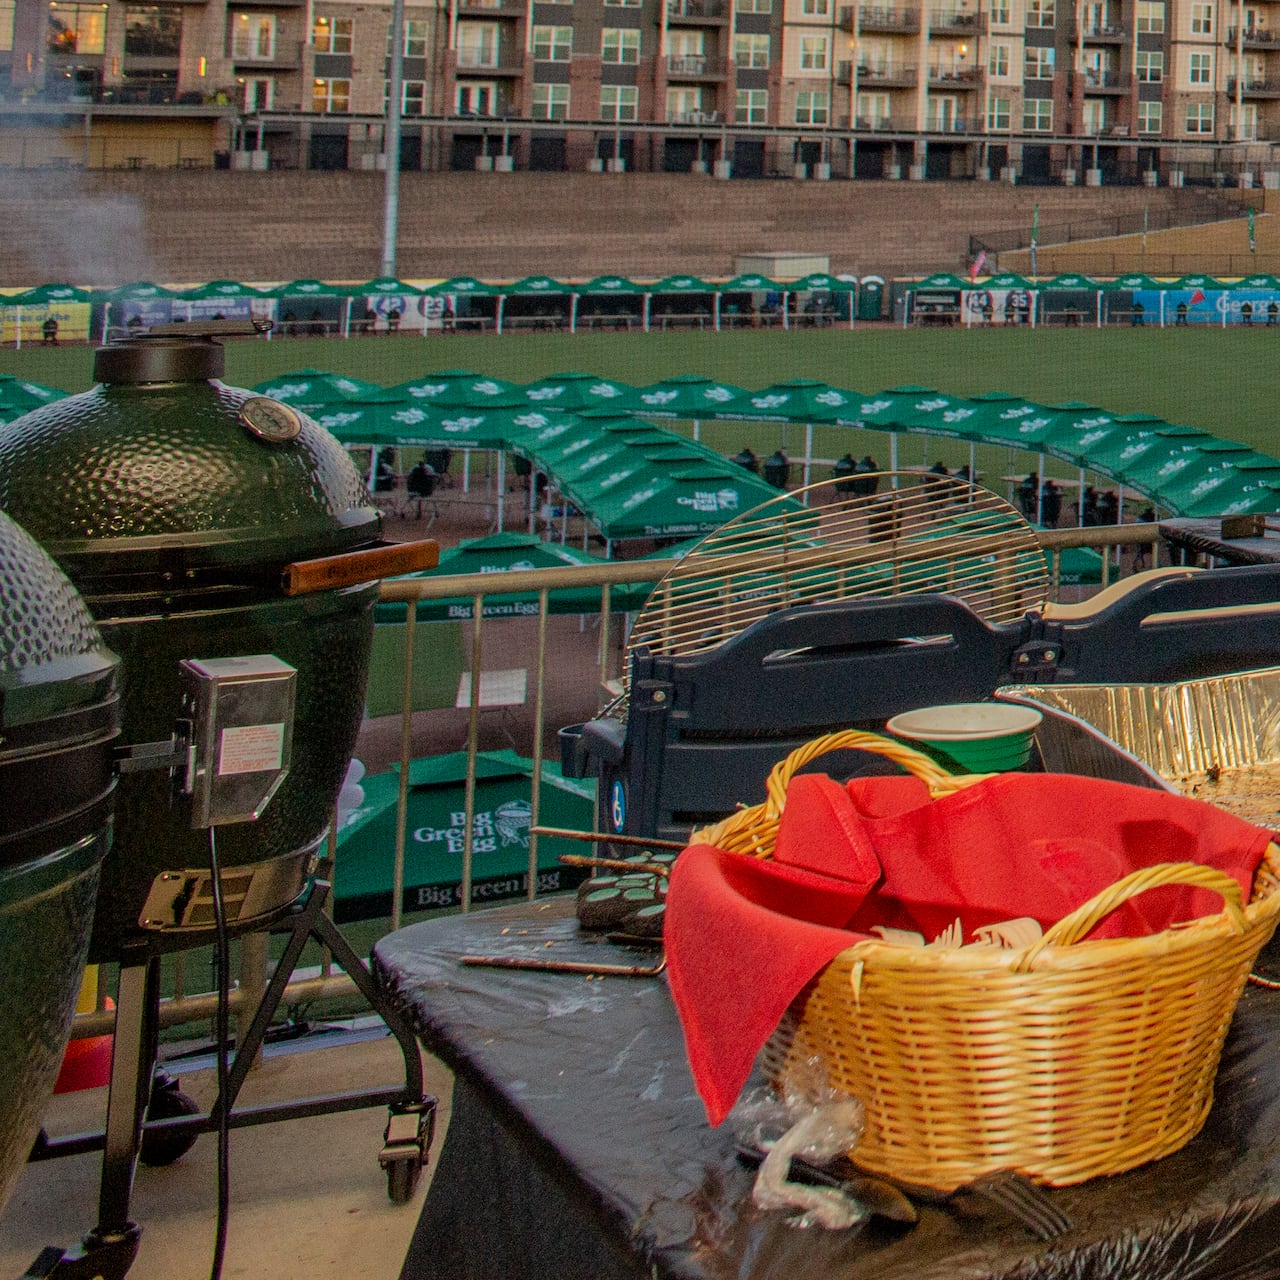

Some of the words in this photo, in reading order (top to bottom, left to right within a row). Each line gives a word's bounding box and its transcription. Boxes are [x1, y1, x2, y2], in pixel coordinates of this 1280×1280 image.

[449, 604, 472, 618] Big
[450, 811, 493, 827] Bg
[417, 887, 453, 906] Big
